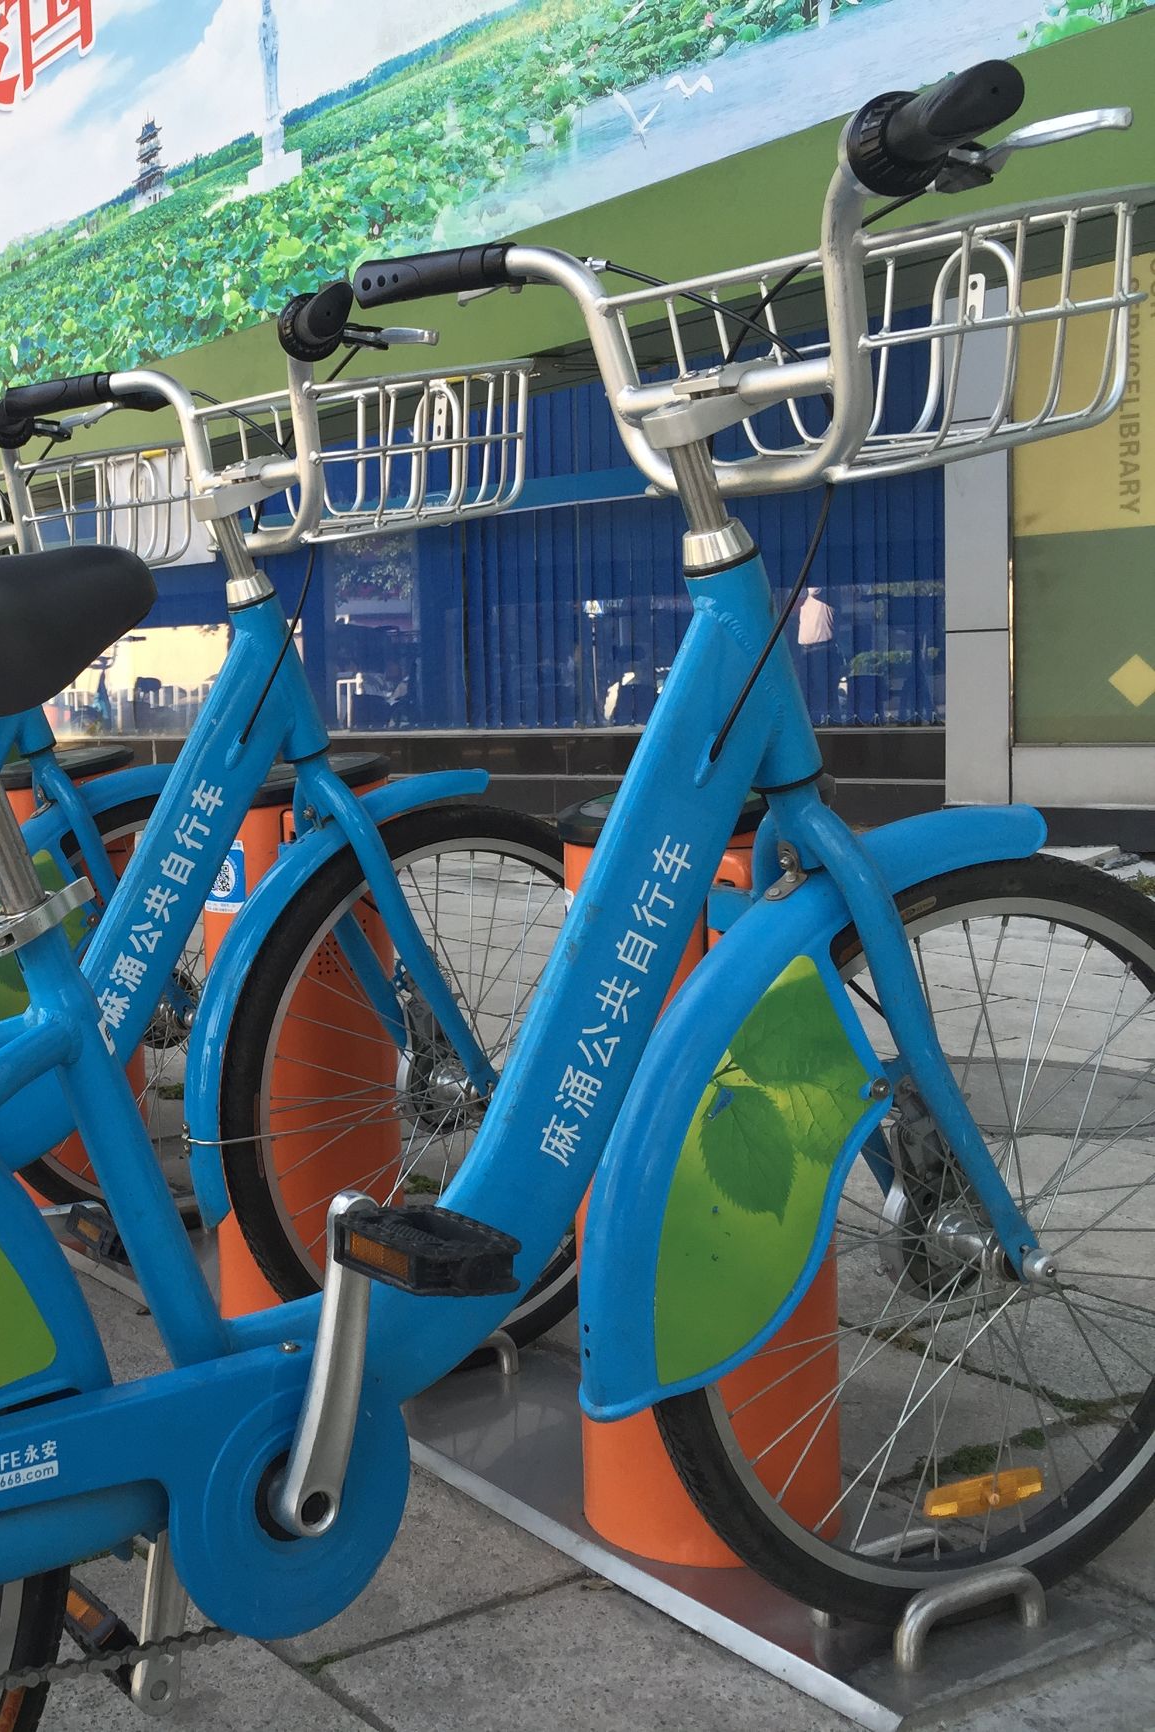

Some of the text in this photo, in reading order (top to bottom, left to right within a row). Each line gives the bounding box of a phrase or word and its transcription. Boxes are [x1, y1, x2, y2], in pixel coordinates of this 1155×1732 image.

[1119, 398, 1141, 515] LIBRARY
[96, 778, 225, 1057] 麻涌公共自行车
[539, 834, 693, 1169] 麻涌公共自行车
[23, 1439, 59, 1464] 永安
